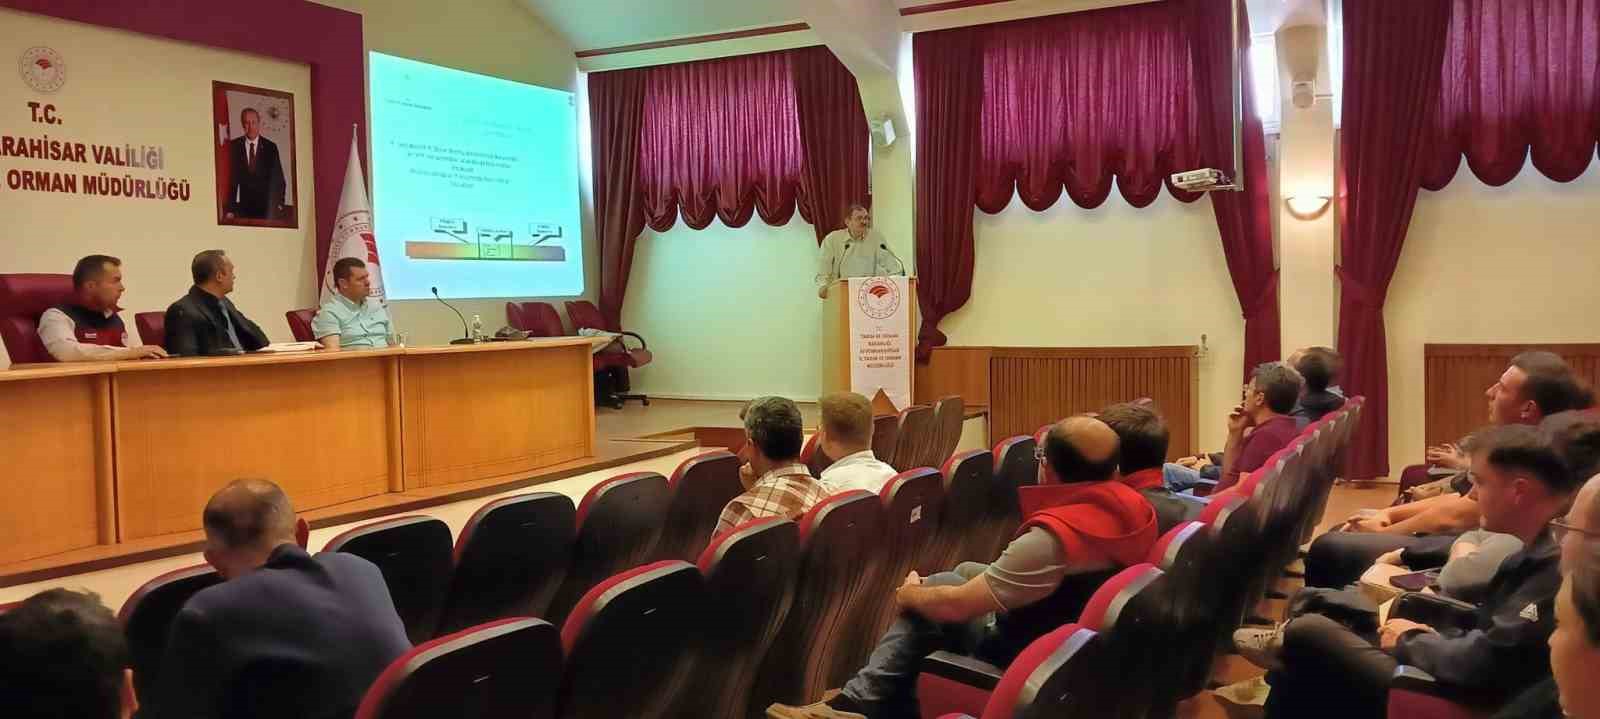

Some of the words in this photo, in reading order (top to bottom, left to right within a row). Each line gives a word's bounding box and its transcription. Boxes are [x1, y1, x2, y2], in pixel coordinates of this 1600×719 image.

[27, 101, 62, 125] T.C.
[0, 135, 87, 163] RAHİSAR
[91, 144, 164, 170] VALİLİĞİ
[7, 169, 77, 194] ORMAN
[83, 172, 191, 201] MÜDÜRLÜĞÜ
